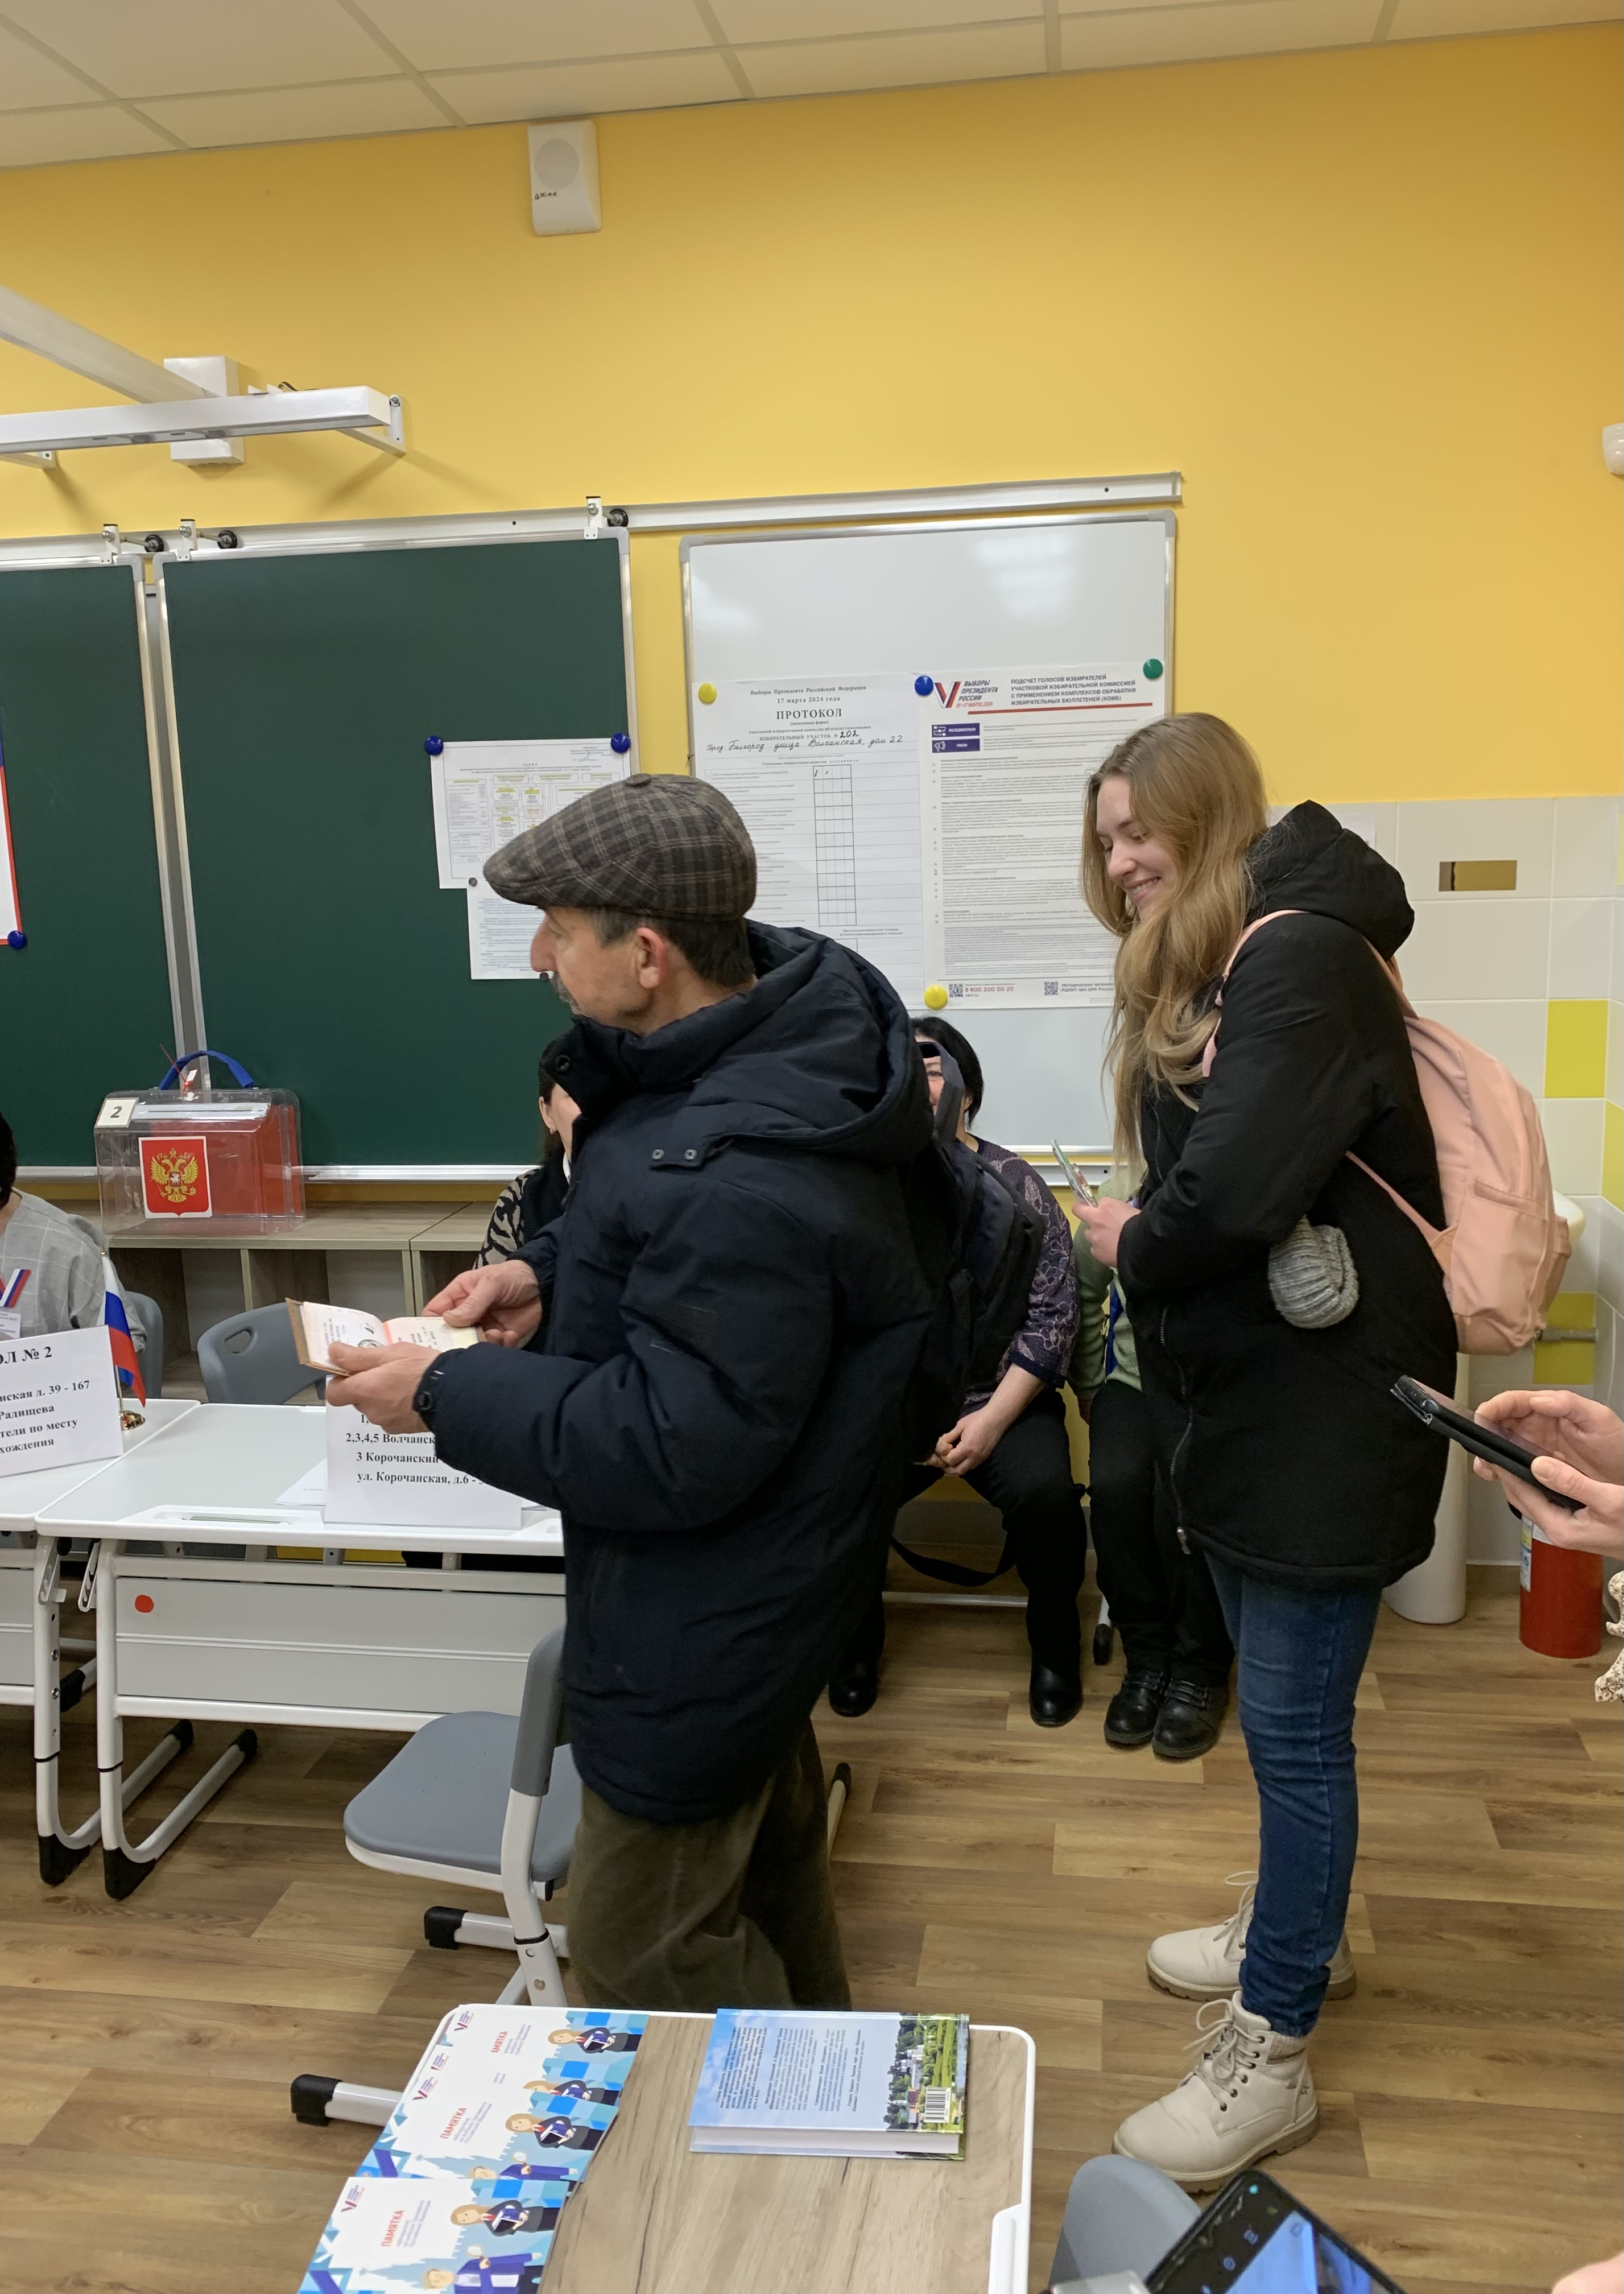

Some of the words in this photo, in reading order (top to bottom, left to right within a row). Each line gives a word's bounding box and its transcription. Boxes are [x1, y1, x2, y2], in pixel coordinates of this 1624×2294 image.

[776, 708, 842, 719] ПРОТОКОЛ
[774, 742, 800, 752] улица
[868, 738, 886, 748] дом
[109, 1106, 123, 1119] 2
[22, 1348, 39, 1361] №
[44, 1346, 52, 1358] 2
[0, 1391, 32, 1402] нская
[48, 1385, 61, 1394] 39
[72, 1380, 90, 1391] 167
[0, 1428, 26, 1438] тели
[47, 1420, 78, 1430] месту
[346, 1433, 379, 1444] 2,3,4,5
[383, 1434, 436, 1444] Волчанск
[0, 1439, 55, 1454] хождения
[356, 1452, 362, 1461] 3
[366, 1452, 439, 1464] Корочанский
[357, 1474, 373, 1483] ул.
[376, 1472, 451, 1484] Корочанская,
[453, 1474, 468, 1484] д.6
[491, 2031, 509, 2053] АМЯТКА
[440, 2108, 468, 2139] ПАМЯТКА
[381, 2210, 404, 2247] ПАМЯТКА
